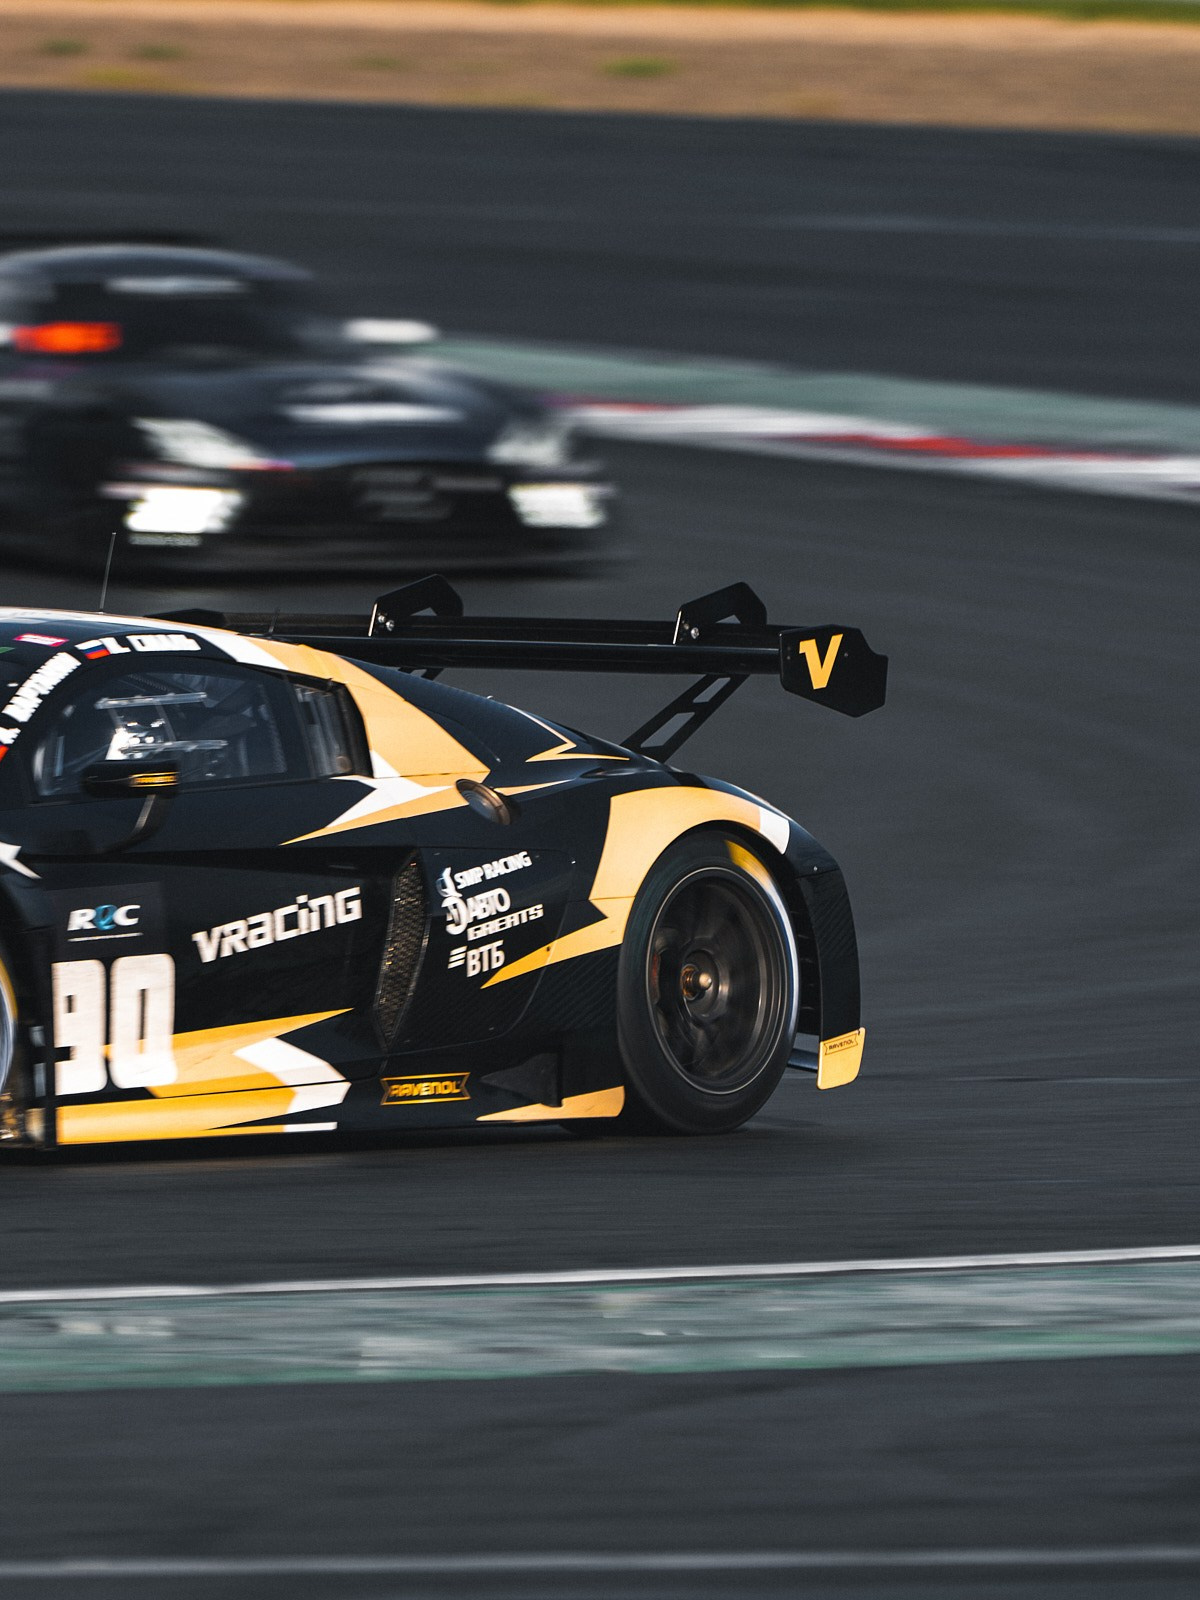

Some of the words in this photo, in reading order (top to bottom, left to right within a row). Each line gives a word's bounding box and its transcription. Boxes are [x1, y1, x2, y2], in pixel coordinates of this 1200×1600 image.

[799, 634, 844, 690] V
[454, 866, 484, 889] SMP
[482, 851, 532, 880] RACING
[50, 953, 179, 1096] 90
[389, 1080, 461, 1097] RAVENOL
